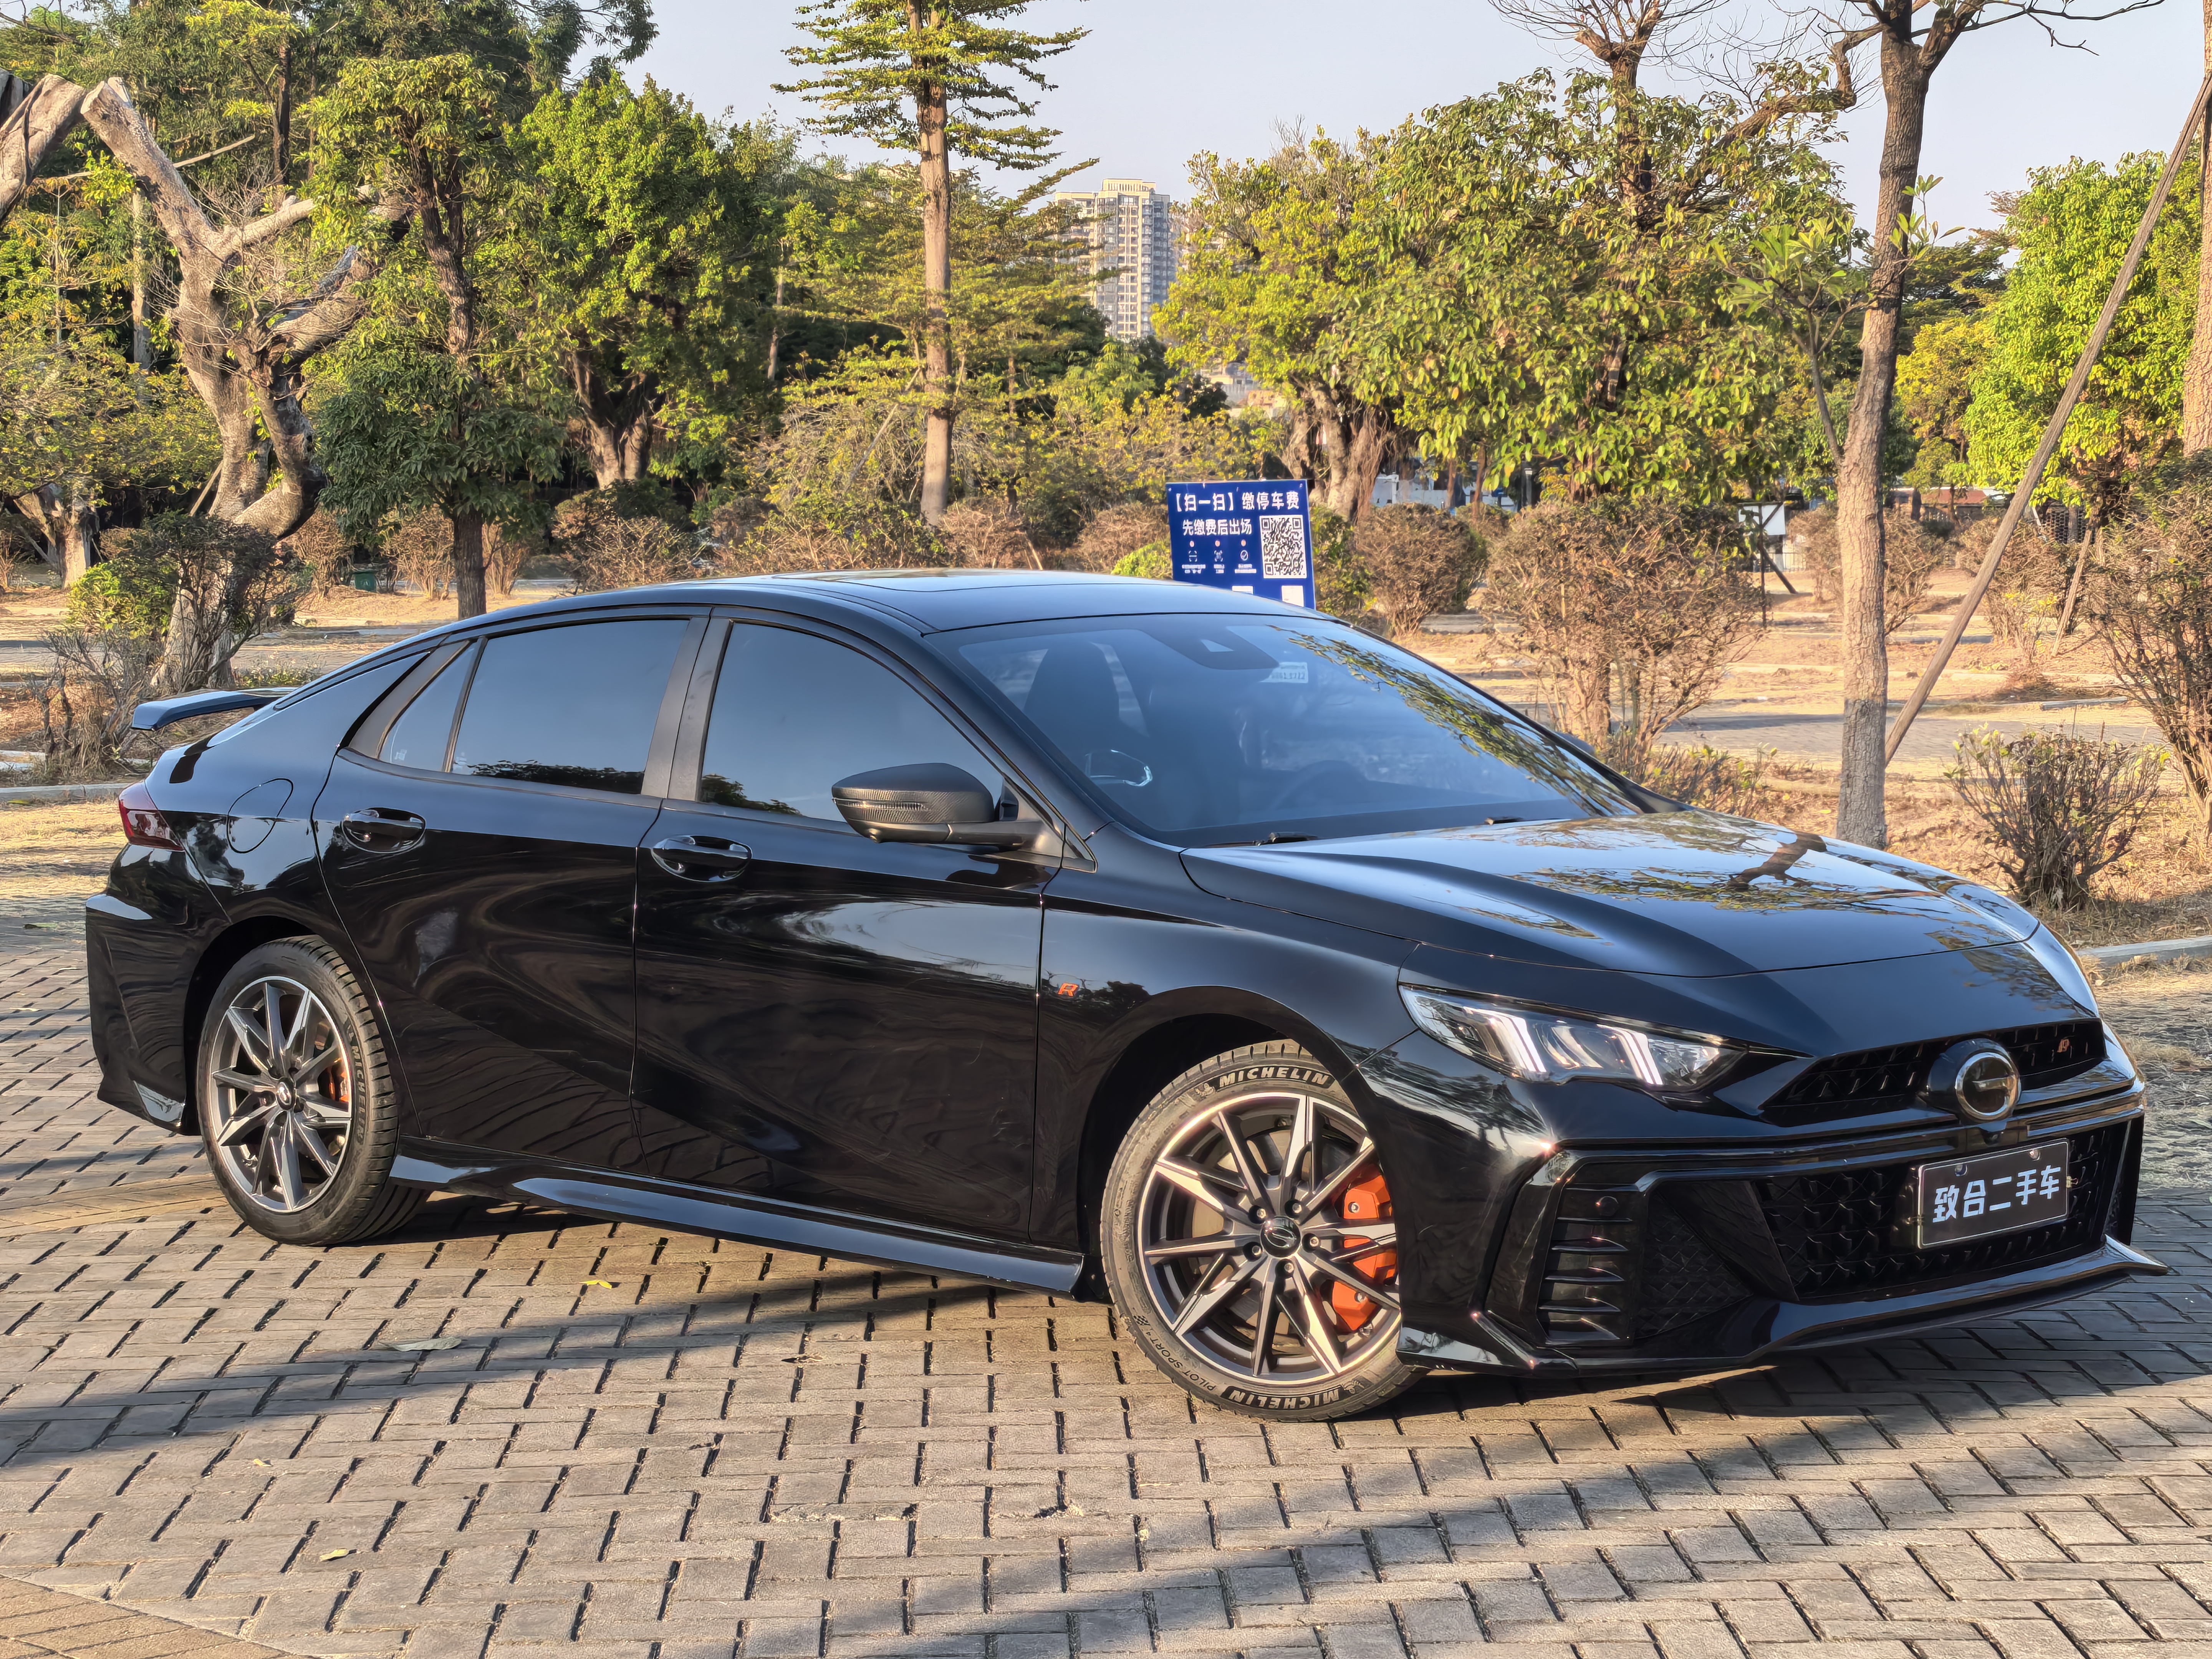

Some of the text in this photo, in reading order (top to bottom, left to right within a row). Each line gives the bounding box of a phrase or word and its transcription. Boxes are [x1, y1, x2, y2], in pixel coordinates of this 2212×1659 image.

[1182, 518, 1252, 535] 先缴费后出场
[1058, 982, 1079, 997] R
[1219, 1067, 1330, 1088] MICHELIN
[1932, 1165, 2061, 1223] 致合二手车
[1150, 1337, 1183, 1368] SPORT
[1182, 1370, 1217, 1391] PILOT
[1229, 1388, 1339, 1409] MICHELIN
